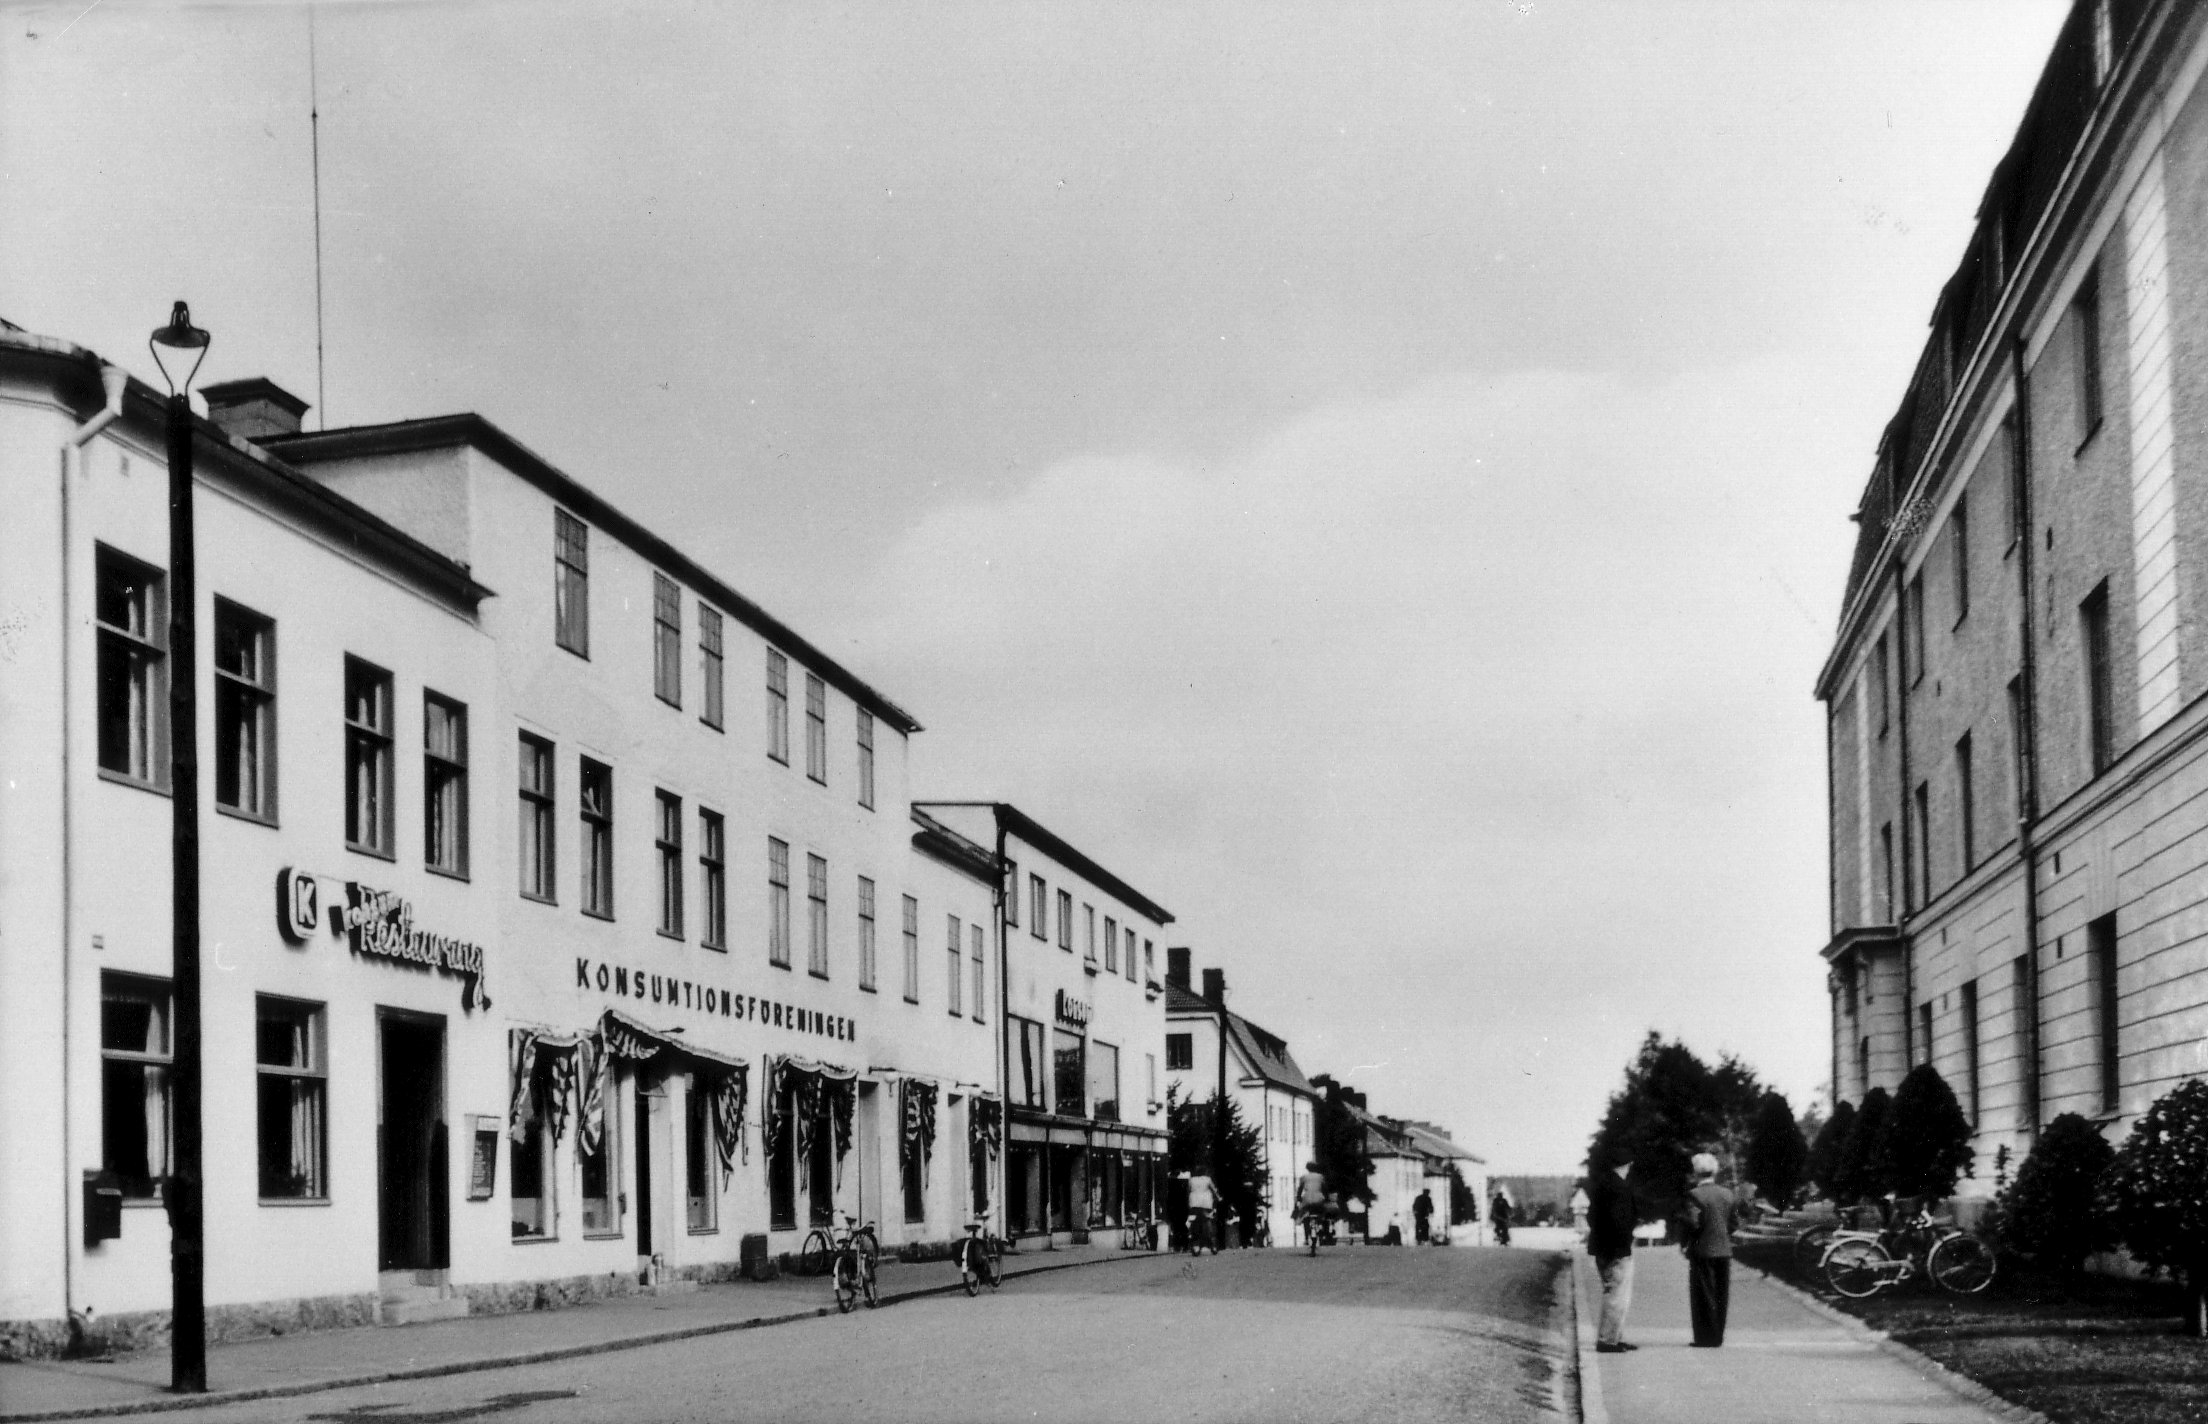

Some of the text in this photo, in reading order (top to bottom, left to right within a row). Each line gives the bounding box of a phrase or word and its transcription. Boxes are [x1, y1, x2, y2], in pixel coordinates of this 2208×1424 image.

[295, 875, 317, 927] K
[357, 884, 485, 1008] Restaurang
[576, 957, 856, 1043] KONSUMTIONSFÖRENINGEN
